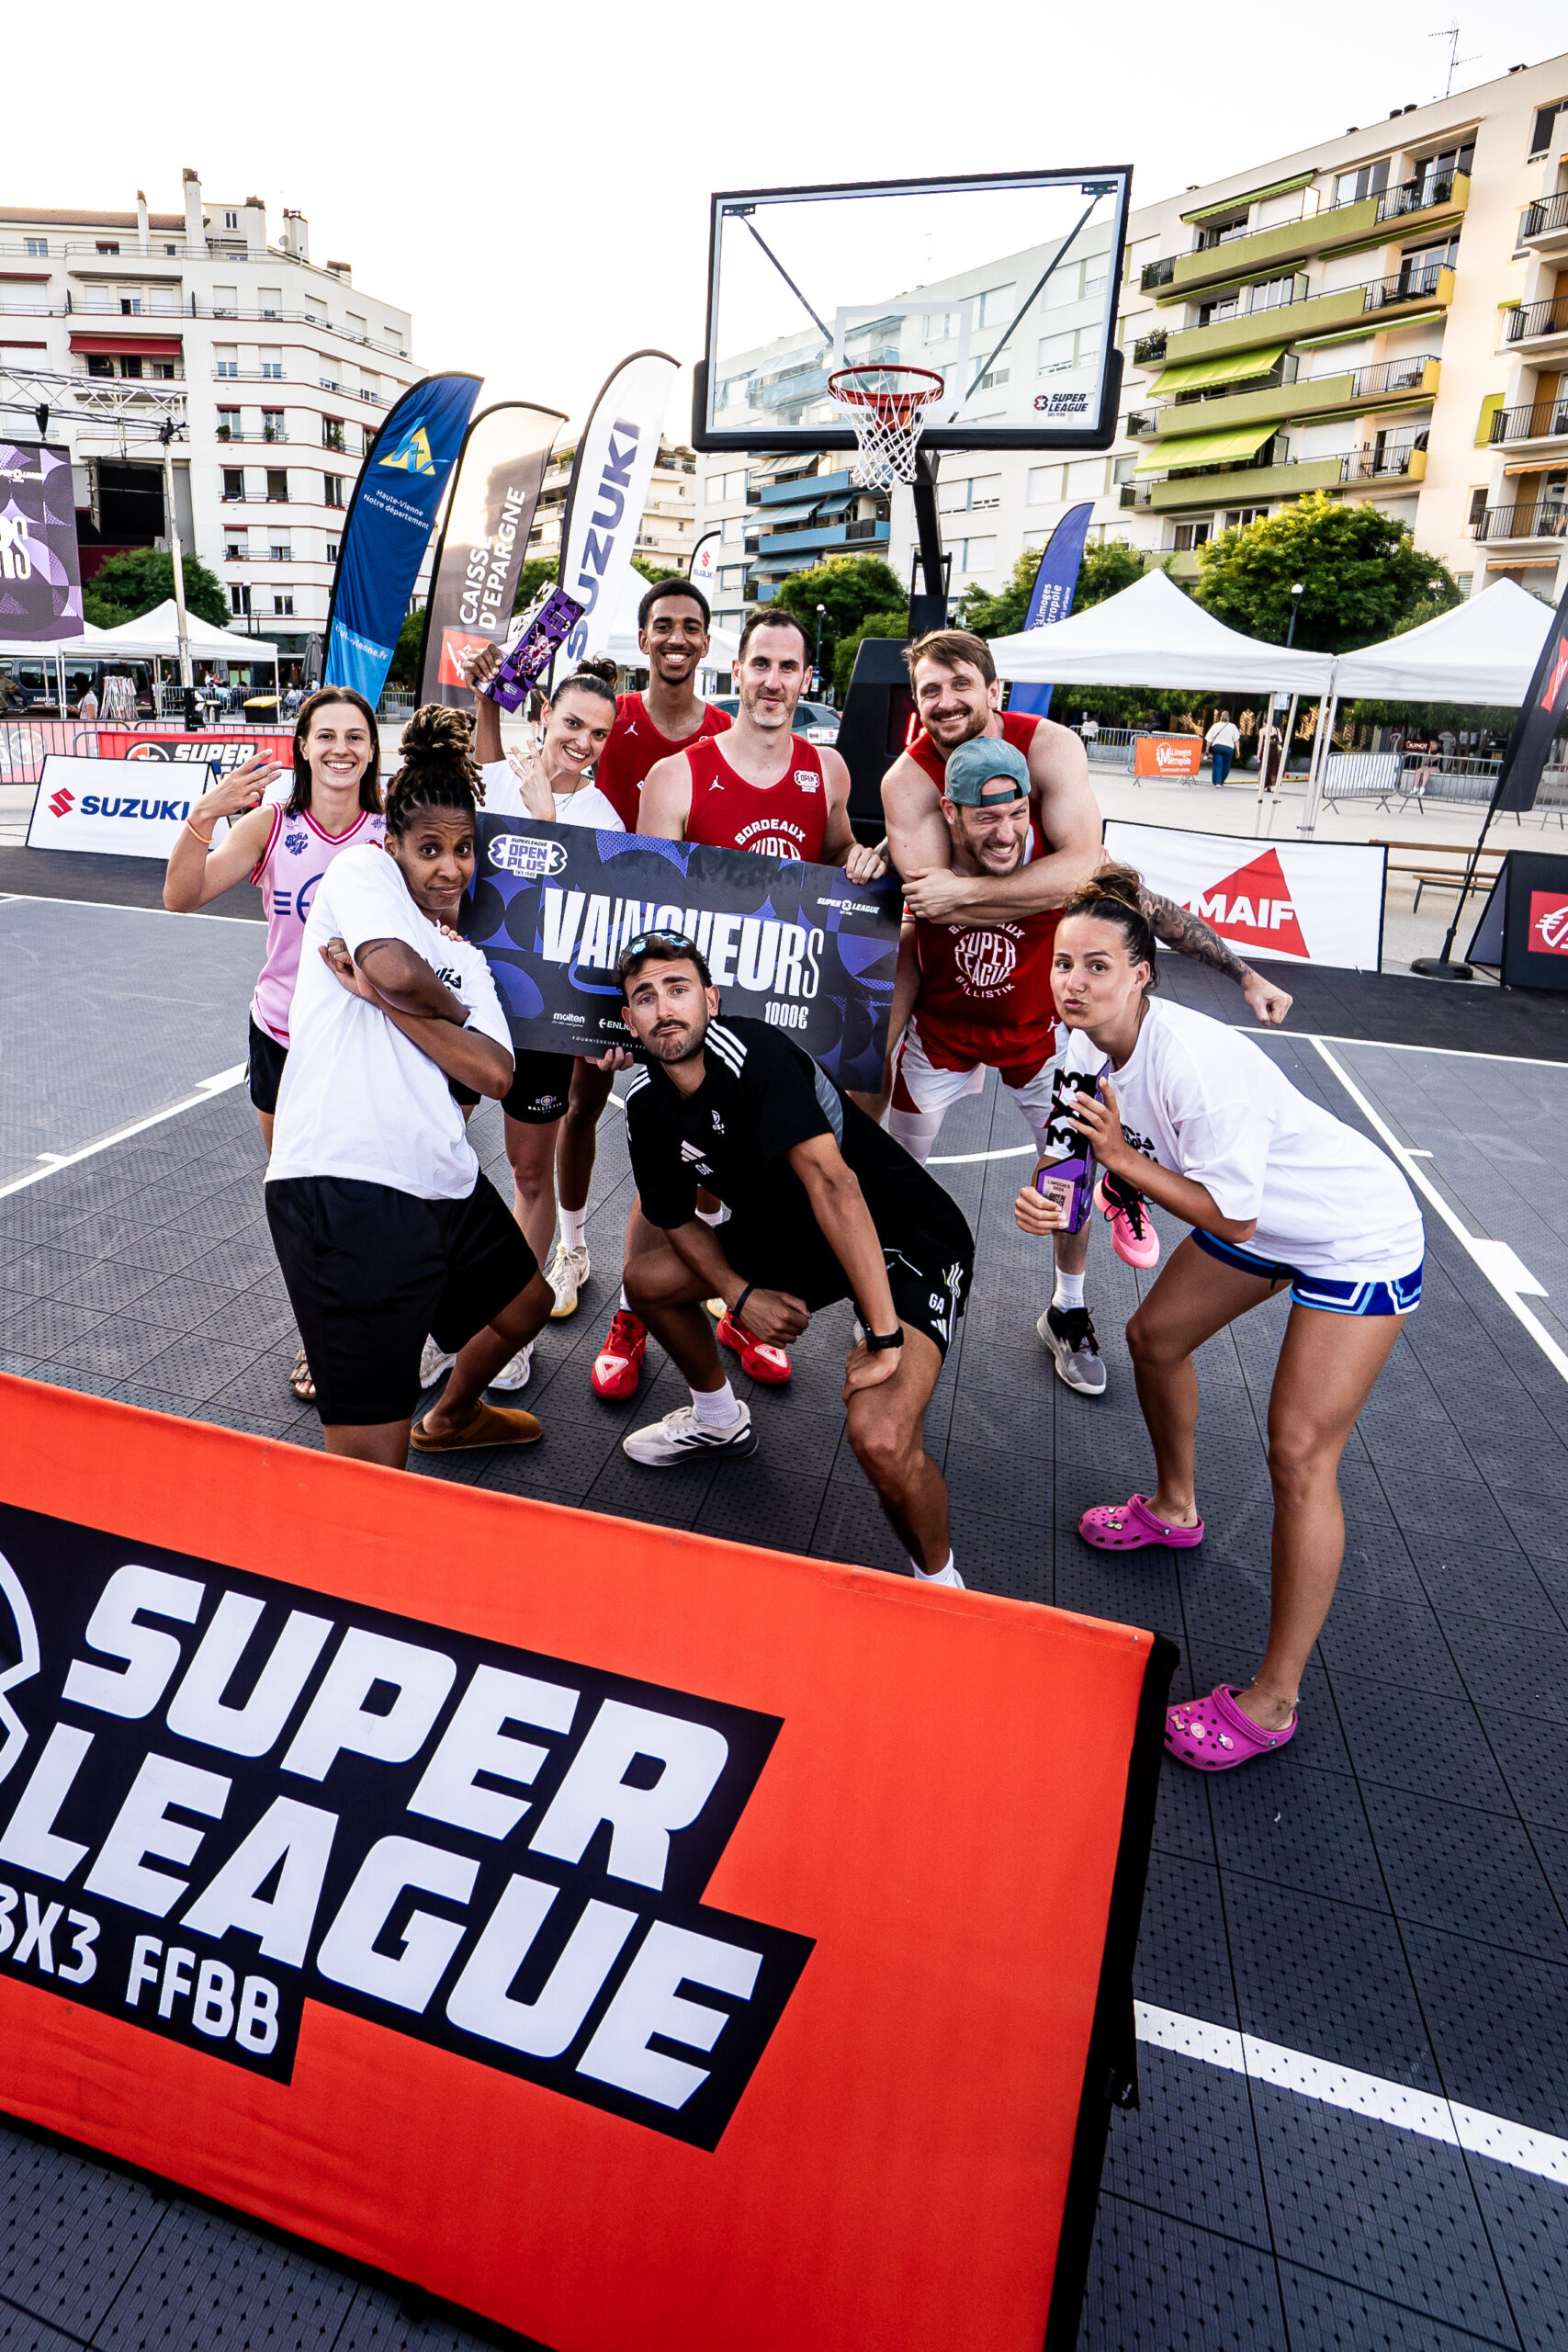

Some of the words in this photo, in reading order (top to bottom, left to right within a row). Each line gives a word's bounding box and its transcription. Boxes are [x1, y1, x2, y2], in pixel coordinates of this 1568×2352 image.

[1048, 403, 1089, 412] LEAGUE
[1052, 393, 1087, 402] SUPER
[363, 493, 385, 508] Notre
[385, 503, 430, 530] département
[376, 489, 424, 516] Haute-Vienne
[567, 417, 641, 661] SUZUKI
[478, 486, 526, 630] D'EPARGNE
[173, 743, 255, 765] SUPER
[80, 795, 190, 820] SUZUKI
[734, 818, 806, 845] BORDEAUX
[506, 856, 546, 872] PLUS
[508, 843, 547, 861] OPEN
[817, 897, 842, 908] SUPER
[852, 902, 880, 914] LEAGUE
[1189, 893, 1295, 930] MAIF
[954, 932, 1017, 967] SUPER
[955, 975, 1015, 998] BALLISTIK
[553, 1012, 585, 1023] molten
[764, 1001, 809, 1031] 1000€
[694, 1162, 715, 1176] GA
[928, 1292, 945, 1315] GA
[62, 1565, 729, 1893] SUPER
[0, 1721, 763, 2110] LEAGUE
[125, 1935, 279, 2054] FFBB
